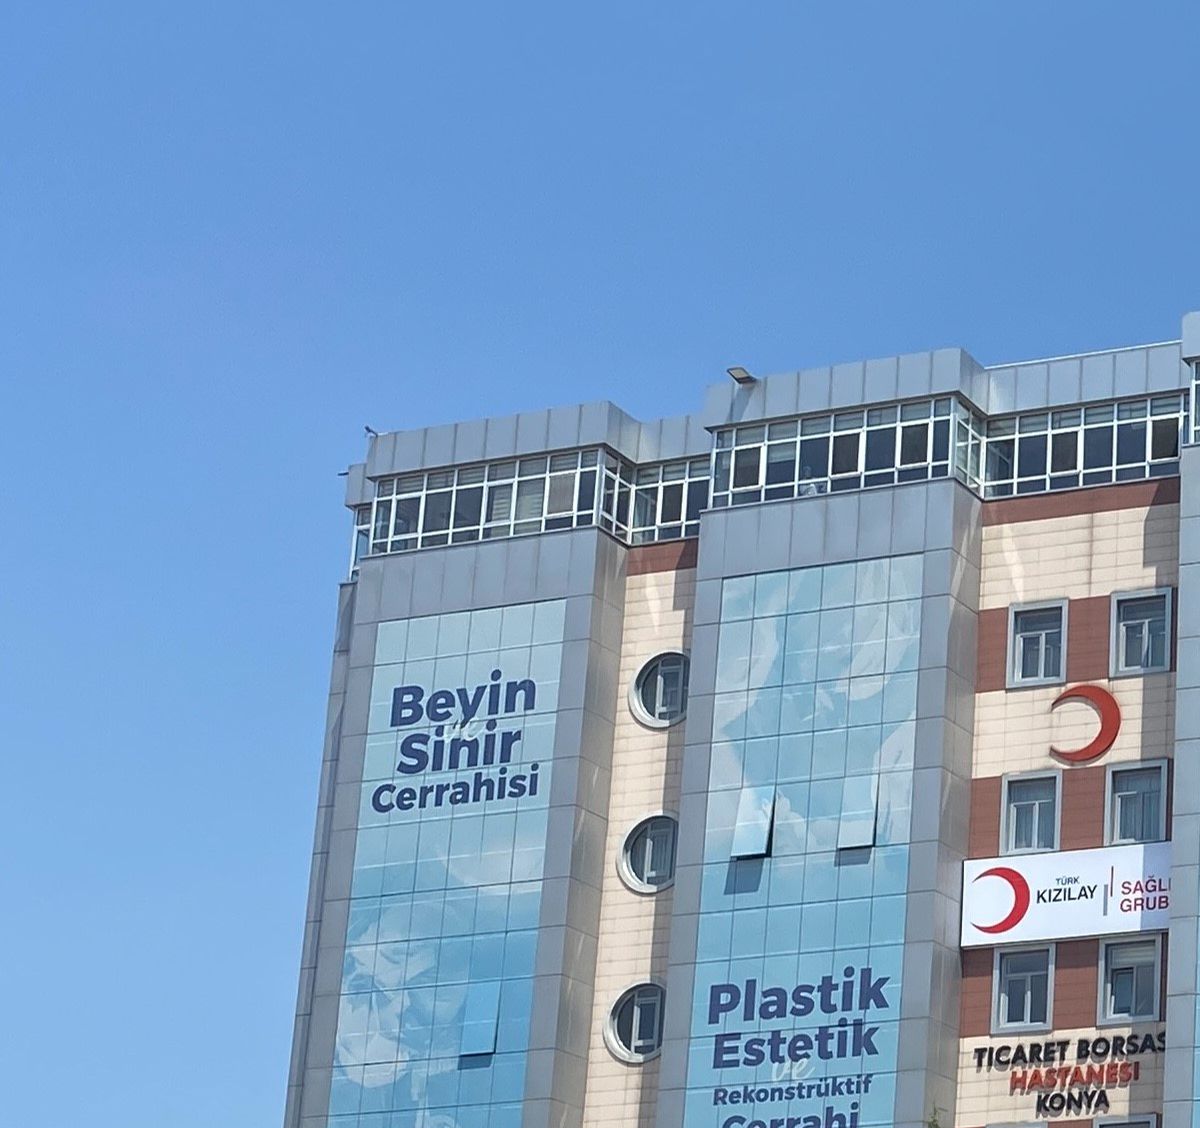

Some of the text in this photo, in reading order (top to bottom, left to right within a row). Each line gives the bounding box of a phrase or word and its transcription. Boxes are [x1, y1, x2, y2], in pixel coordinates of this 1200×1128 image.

[390, 669, 537, 729] Beyin
[396, 719, 522, 775] Sinir
[371, 763, 540, 814] Cerrahisi
[1036, 885, 1098, 904] KIZILAY
[1056, 876, 1080, 886] TÜRK
[708, 966, 891, 1026] Plastik
[712, 1017, 880, 1070] Estetik
[713, 1074, 874, 1106] Rekonstrüktif
[771, 1057, 815, 1083] ve
[1036, 1090, 1110, 1114] KONYA
